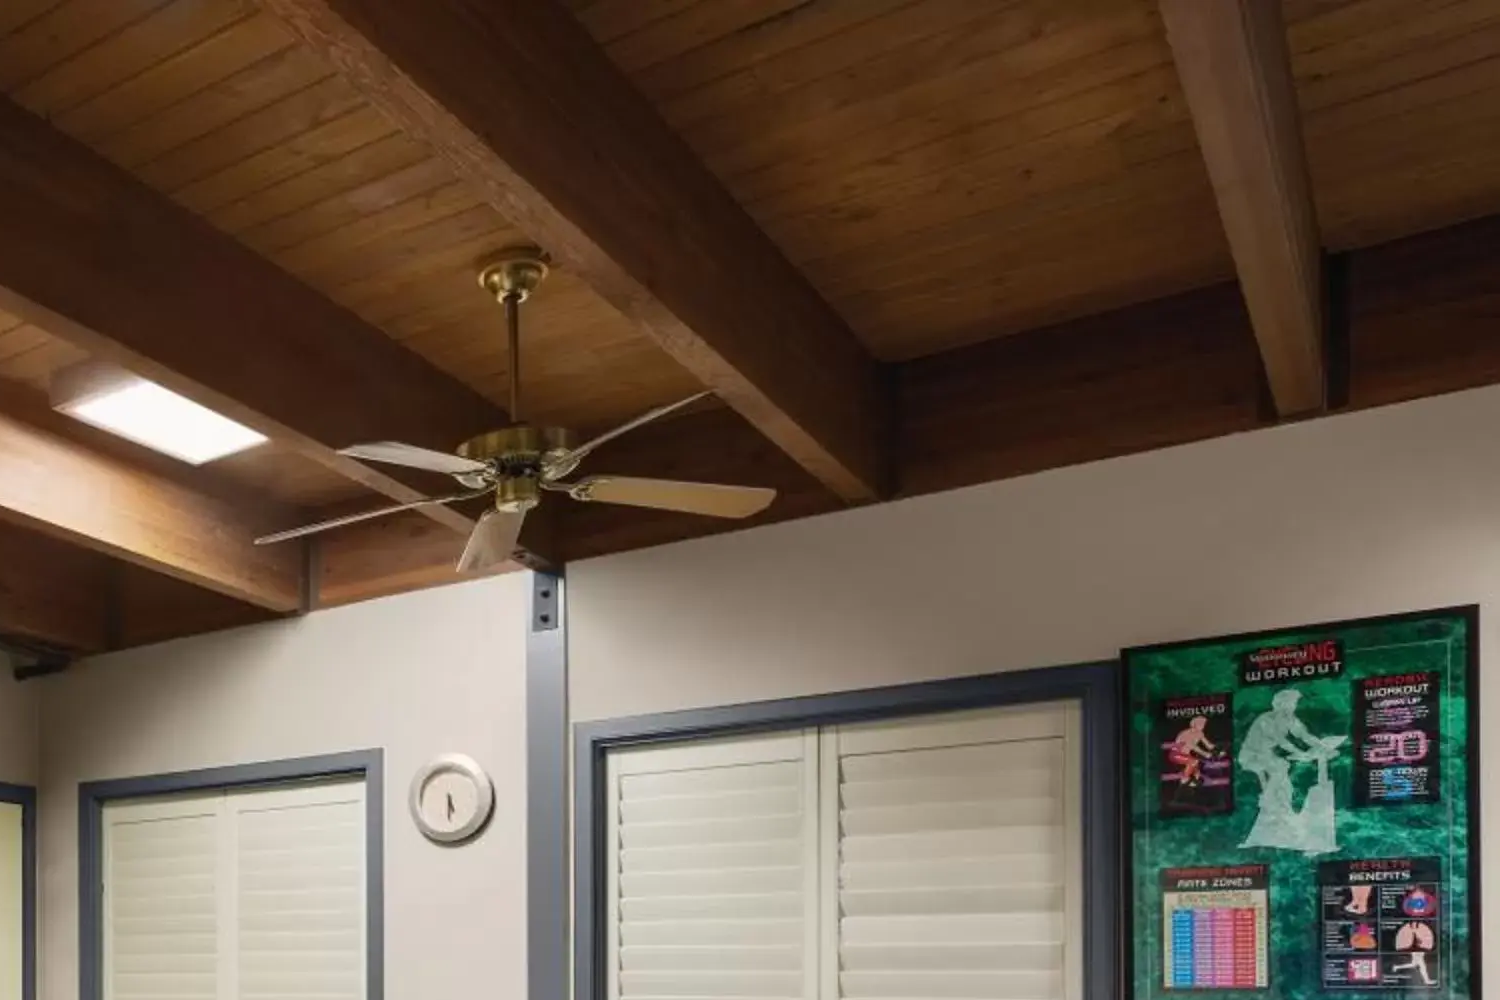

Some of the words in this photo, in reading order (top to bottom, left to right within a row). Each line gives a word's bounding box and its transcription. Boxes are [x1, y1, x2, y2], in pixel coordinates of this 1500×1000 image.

[1245, 661, 1341, 682] WORKOUT
[1364, 683, 1429, 699] WORKOUT
[1166, 703, 1226, 718] INVOLVED
